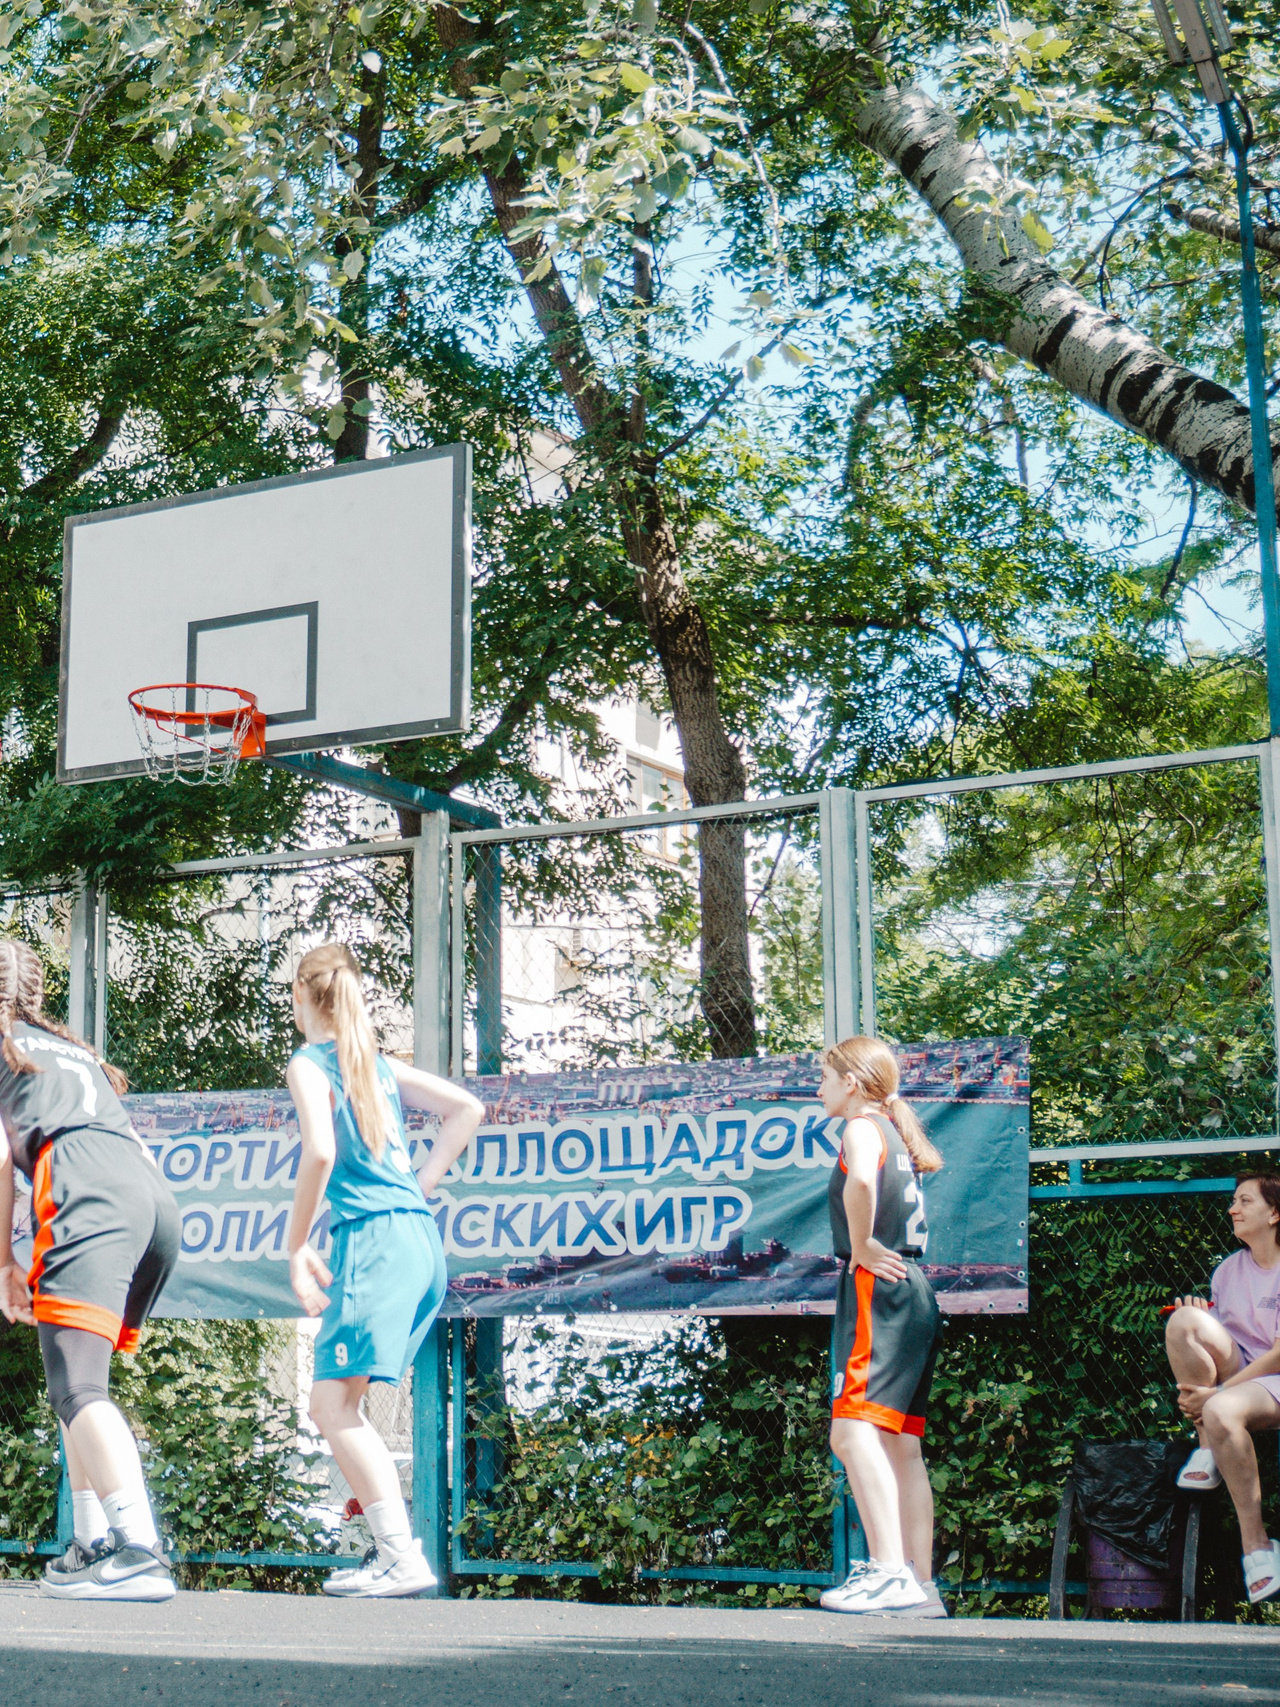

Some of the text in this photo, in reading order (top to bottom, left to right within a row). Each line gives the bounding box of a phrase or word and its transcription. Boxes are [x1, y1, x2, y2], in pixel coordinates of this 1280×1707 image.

[472, 1113, 841, 1176] ПЛОЩАДОК
[635, 1196, 743, 1246] ИГР
[335, 1342, 348, 1367] 9
